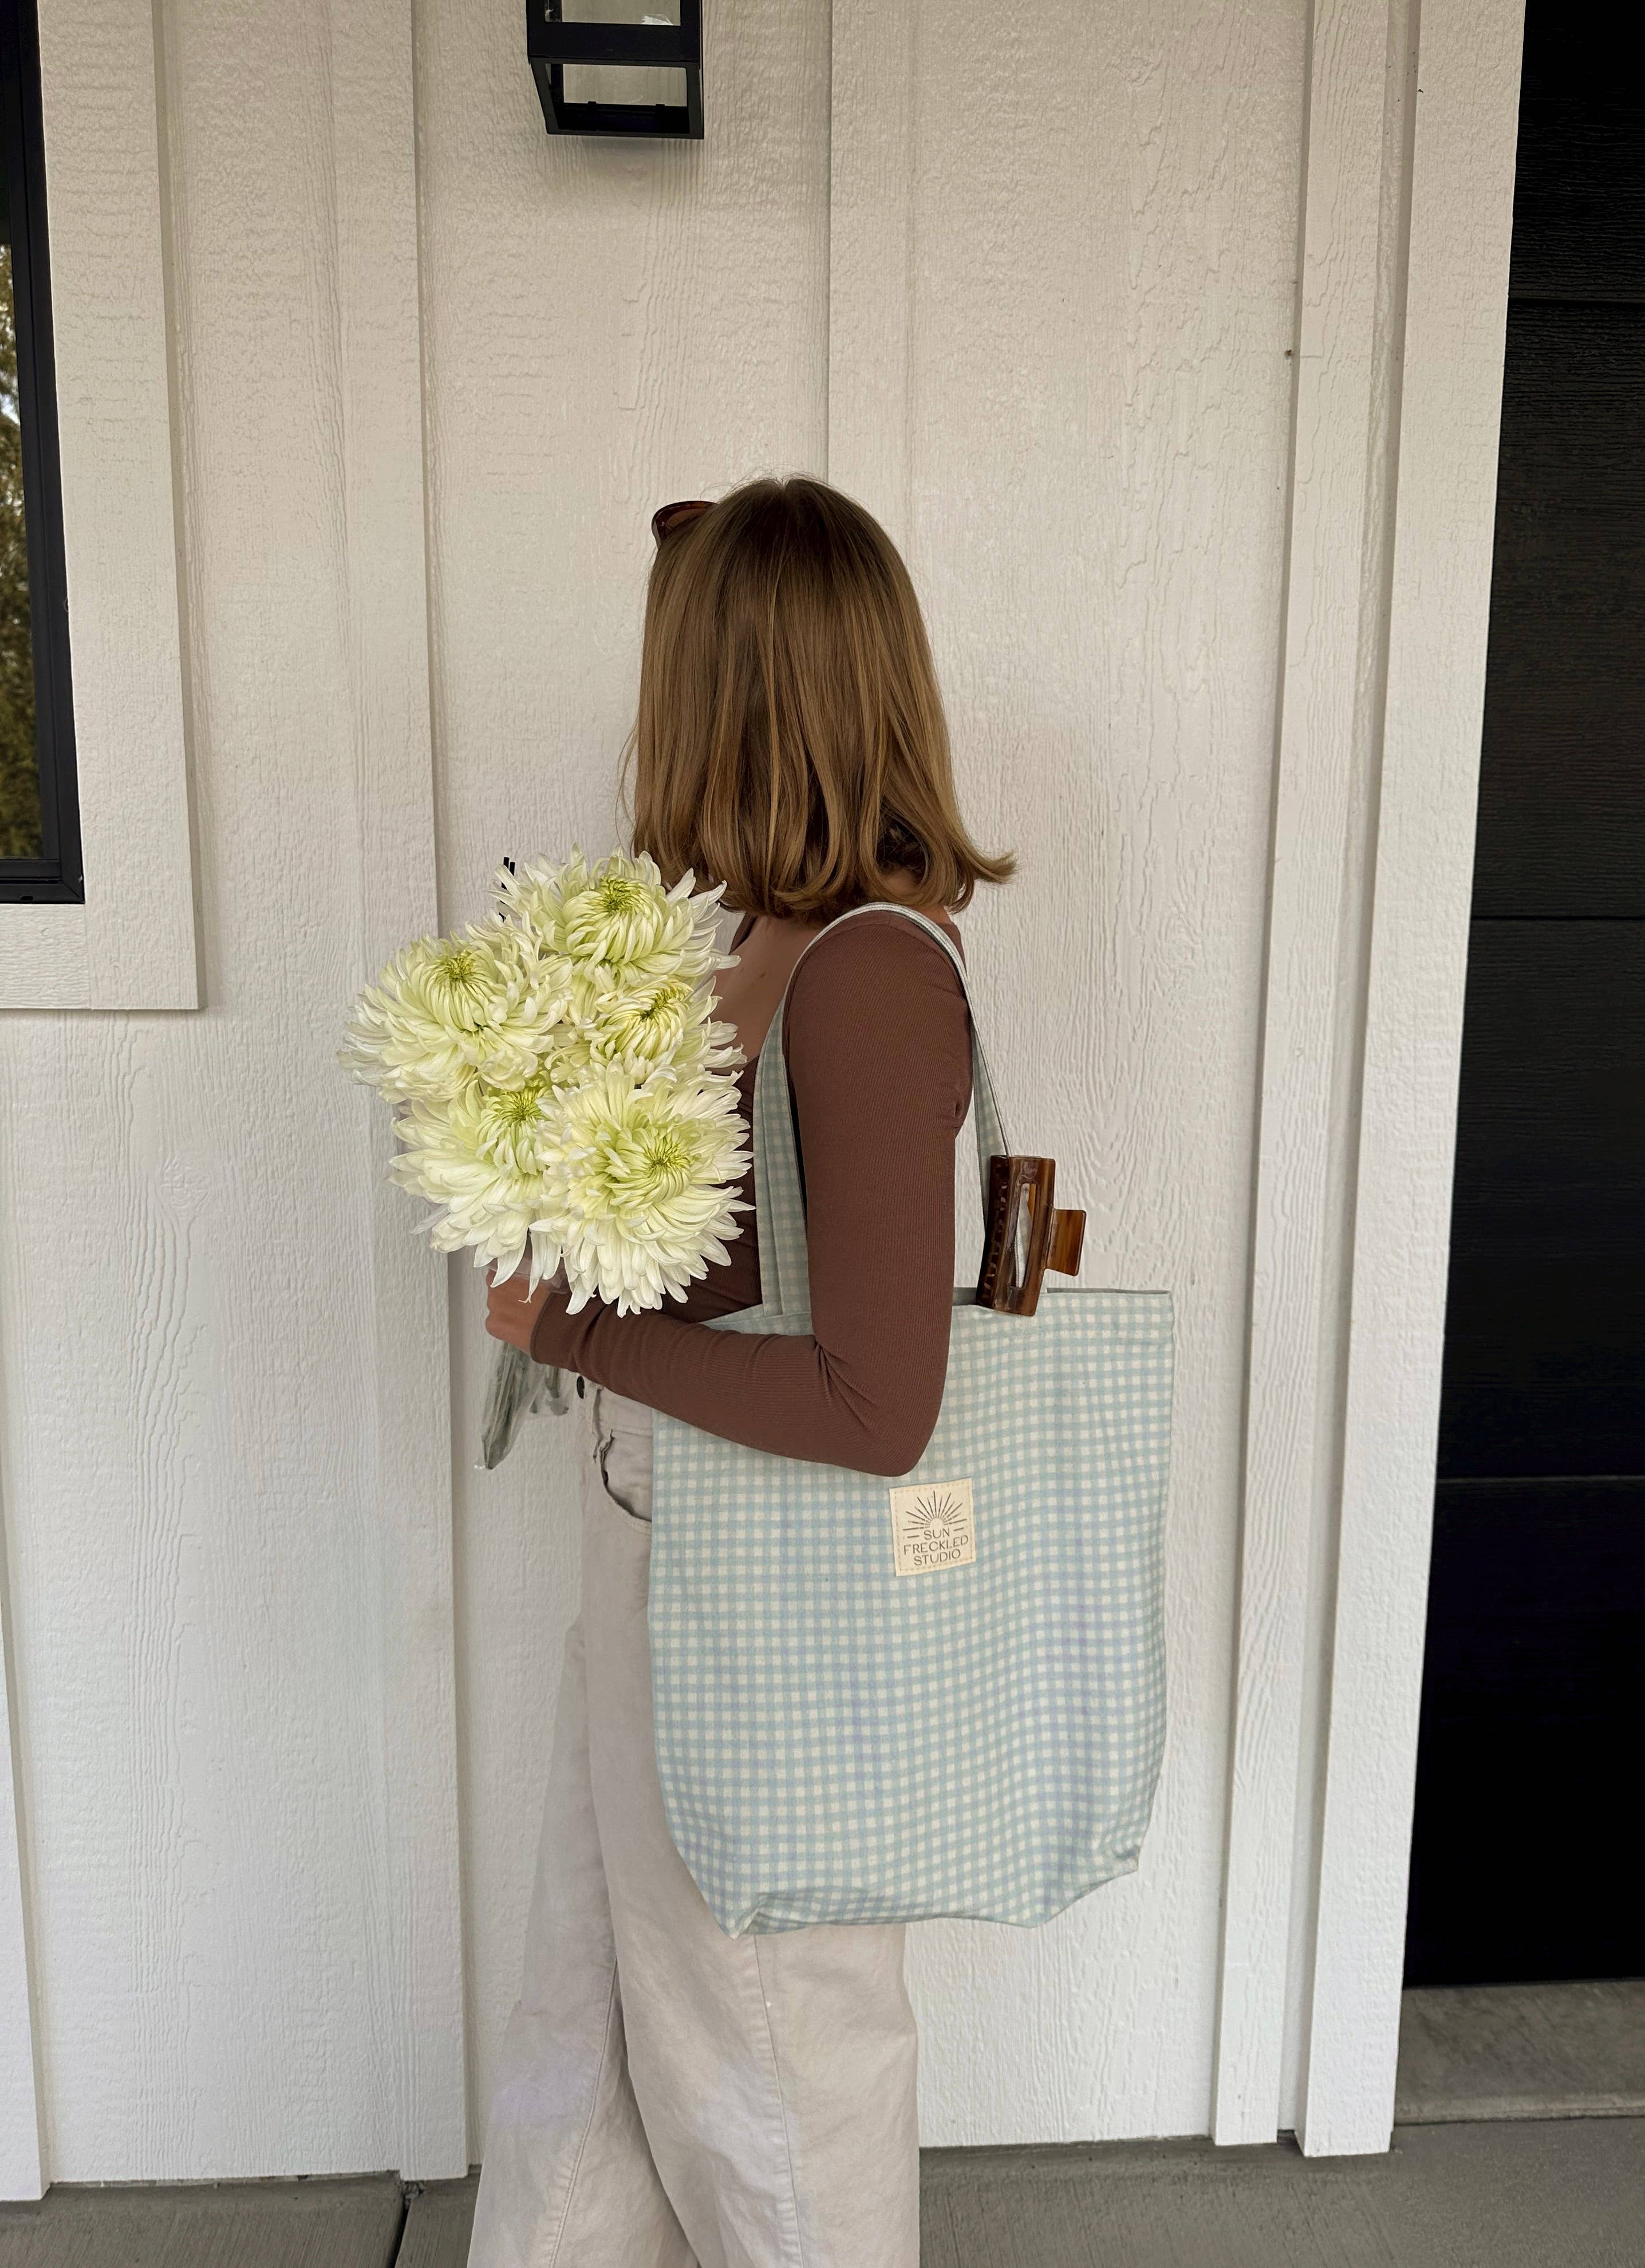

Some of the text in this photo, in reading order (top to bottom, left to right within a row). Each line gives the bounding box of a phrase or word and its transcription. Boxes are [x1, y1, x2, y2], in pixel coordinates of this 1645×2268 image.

[924, 1527, 950, 1540] SUN
[904, 1535, 969, 1555] FRECKLED
[914, 1549, 961, 1566] STUDIO
